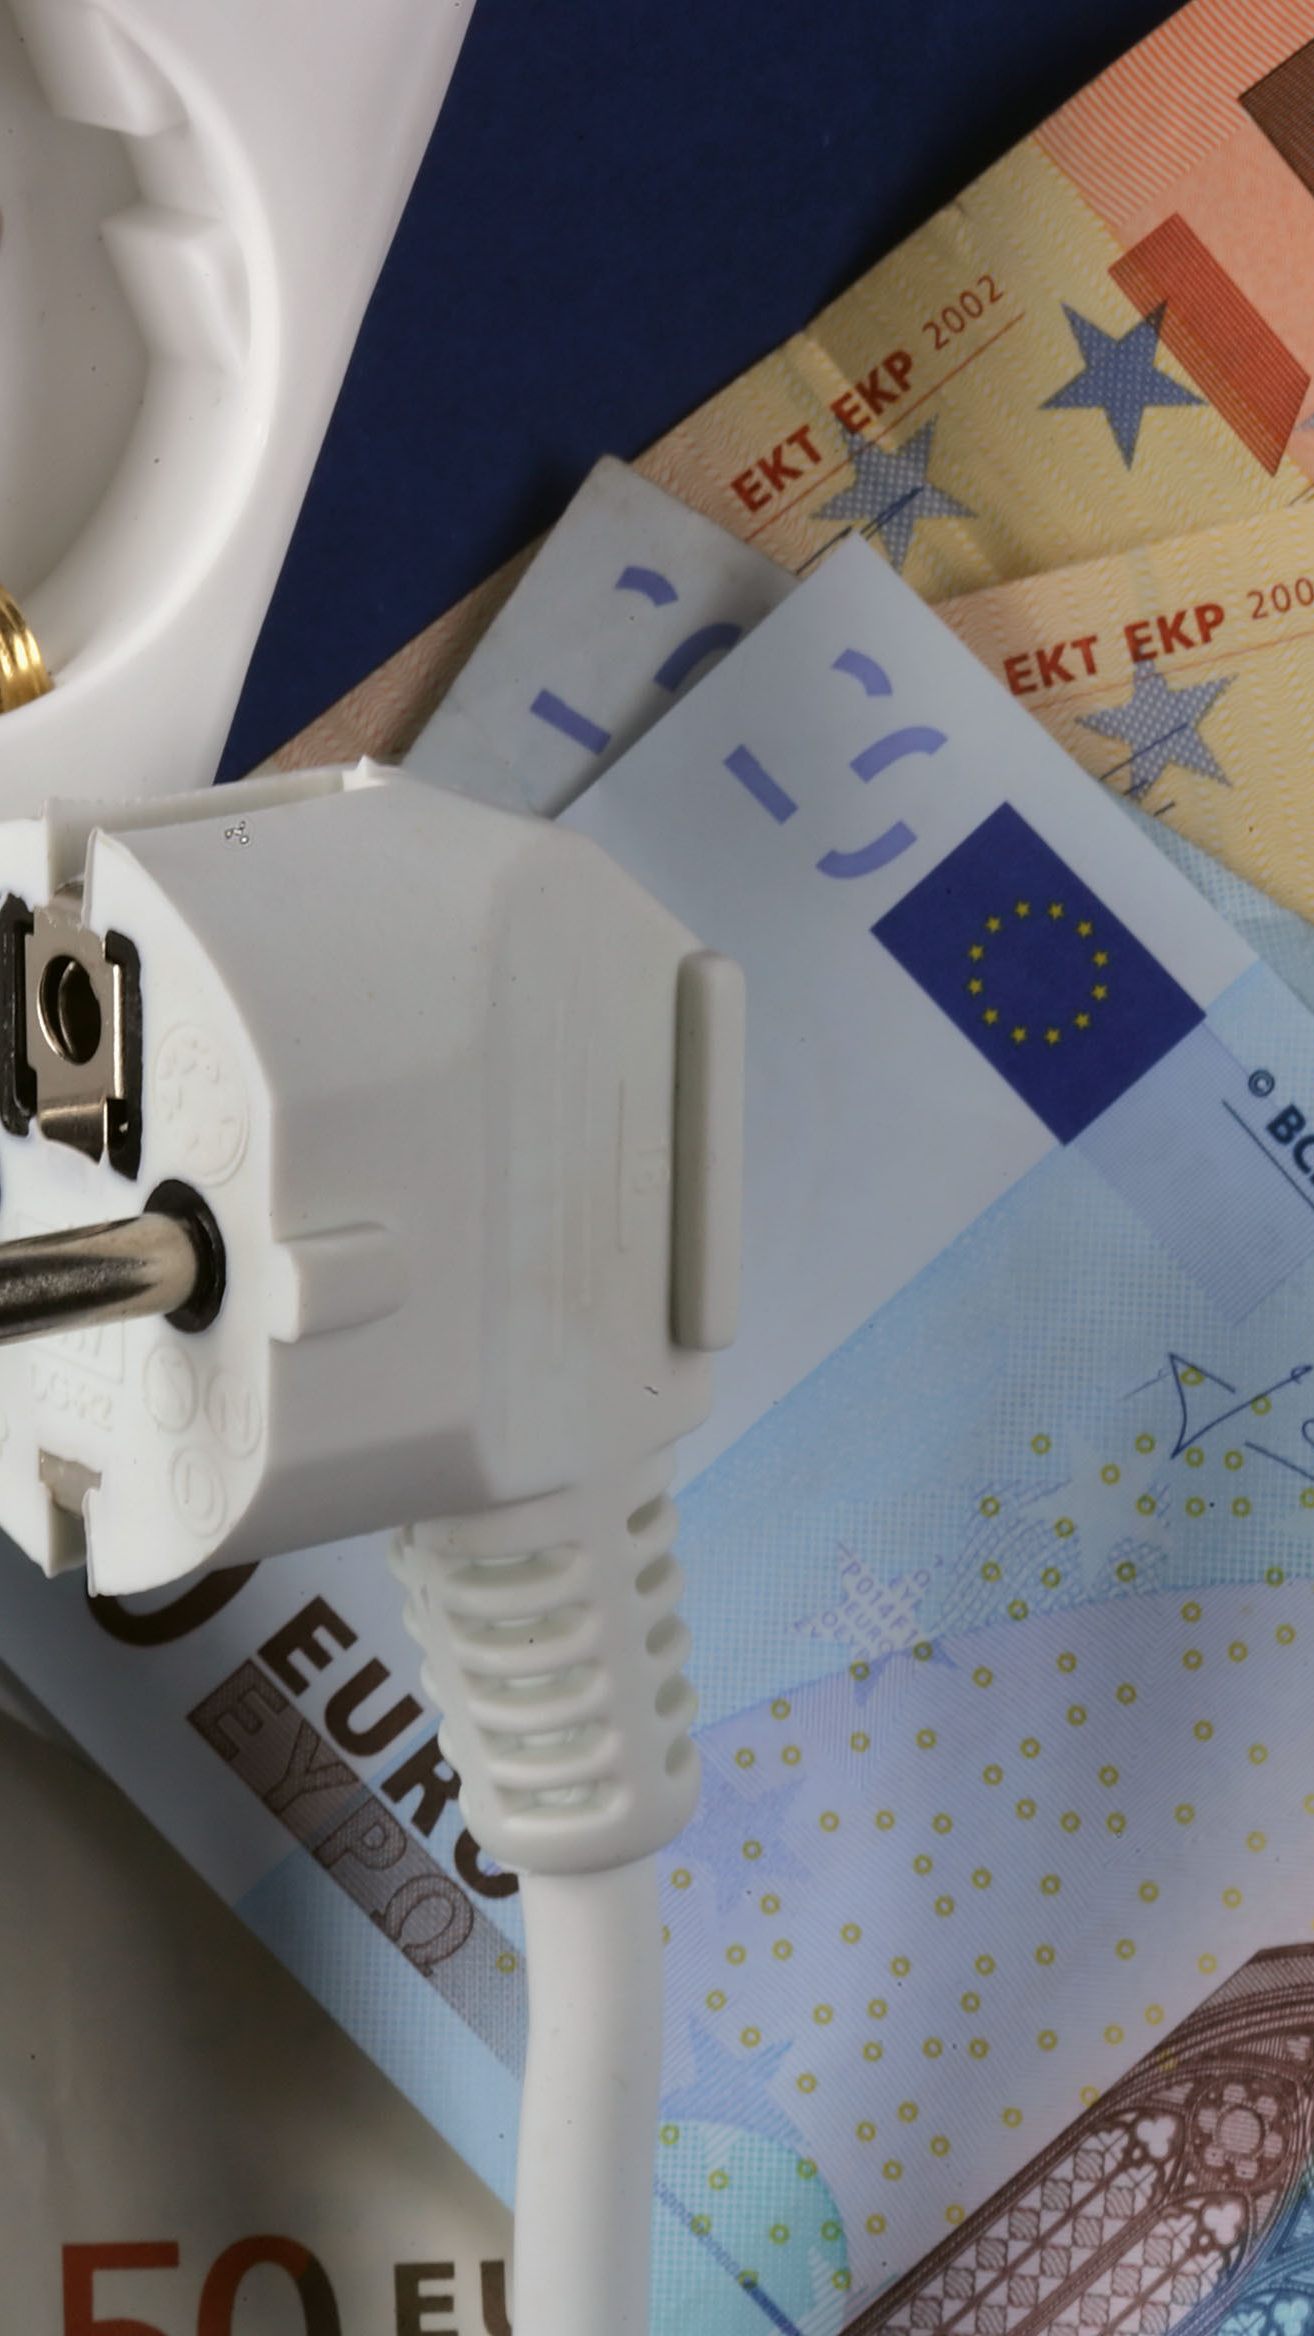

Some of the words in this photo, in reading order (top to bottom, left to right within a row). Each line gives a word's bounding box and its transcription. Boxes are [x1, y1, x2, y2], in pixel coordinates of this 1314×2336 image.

[729, 424, 822, 514] EKT
[828, 350, 914, 434] EKP
[921, 274, 1004, 351] 2002
[1002, 634, 1099, 696] EKT
[1123, 602, 1226, 662] EKP
[1266, 1103, 1314, 1187] BC
